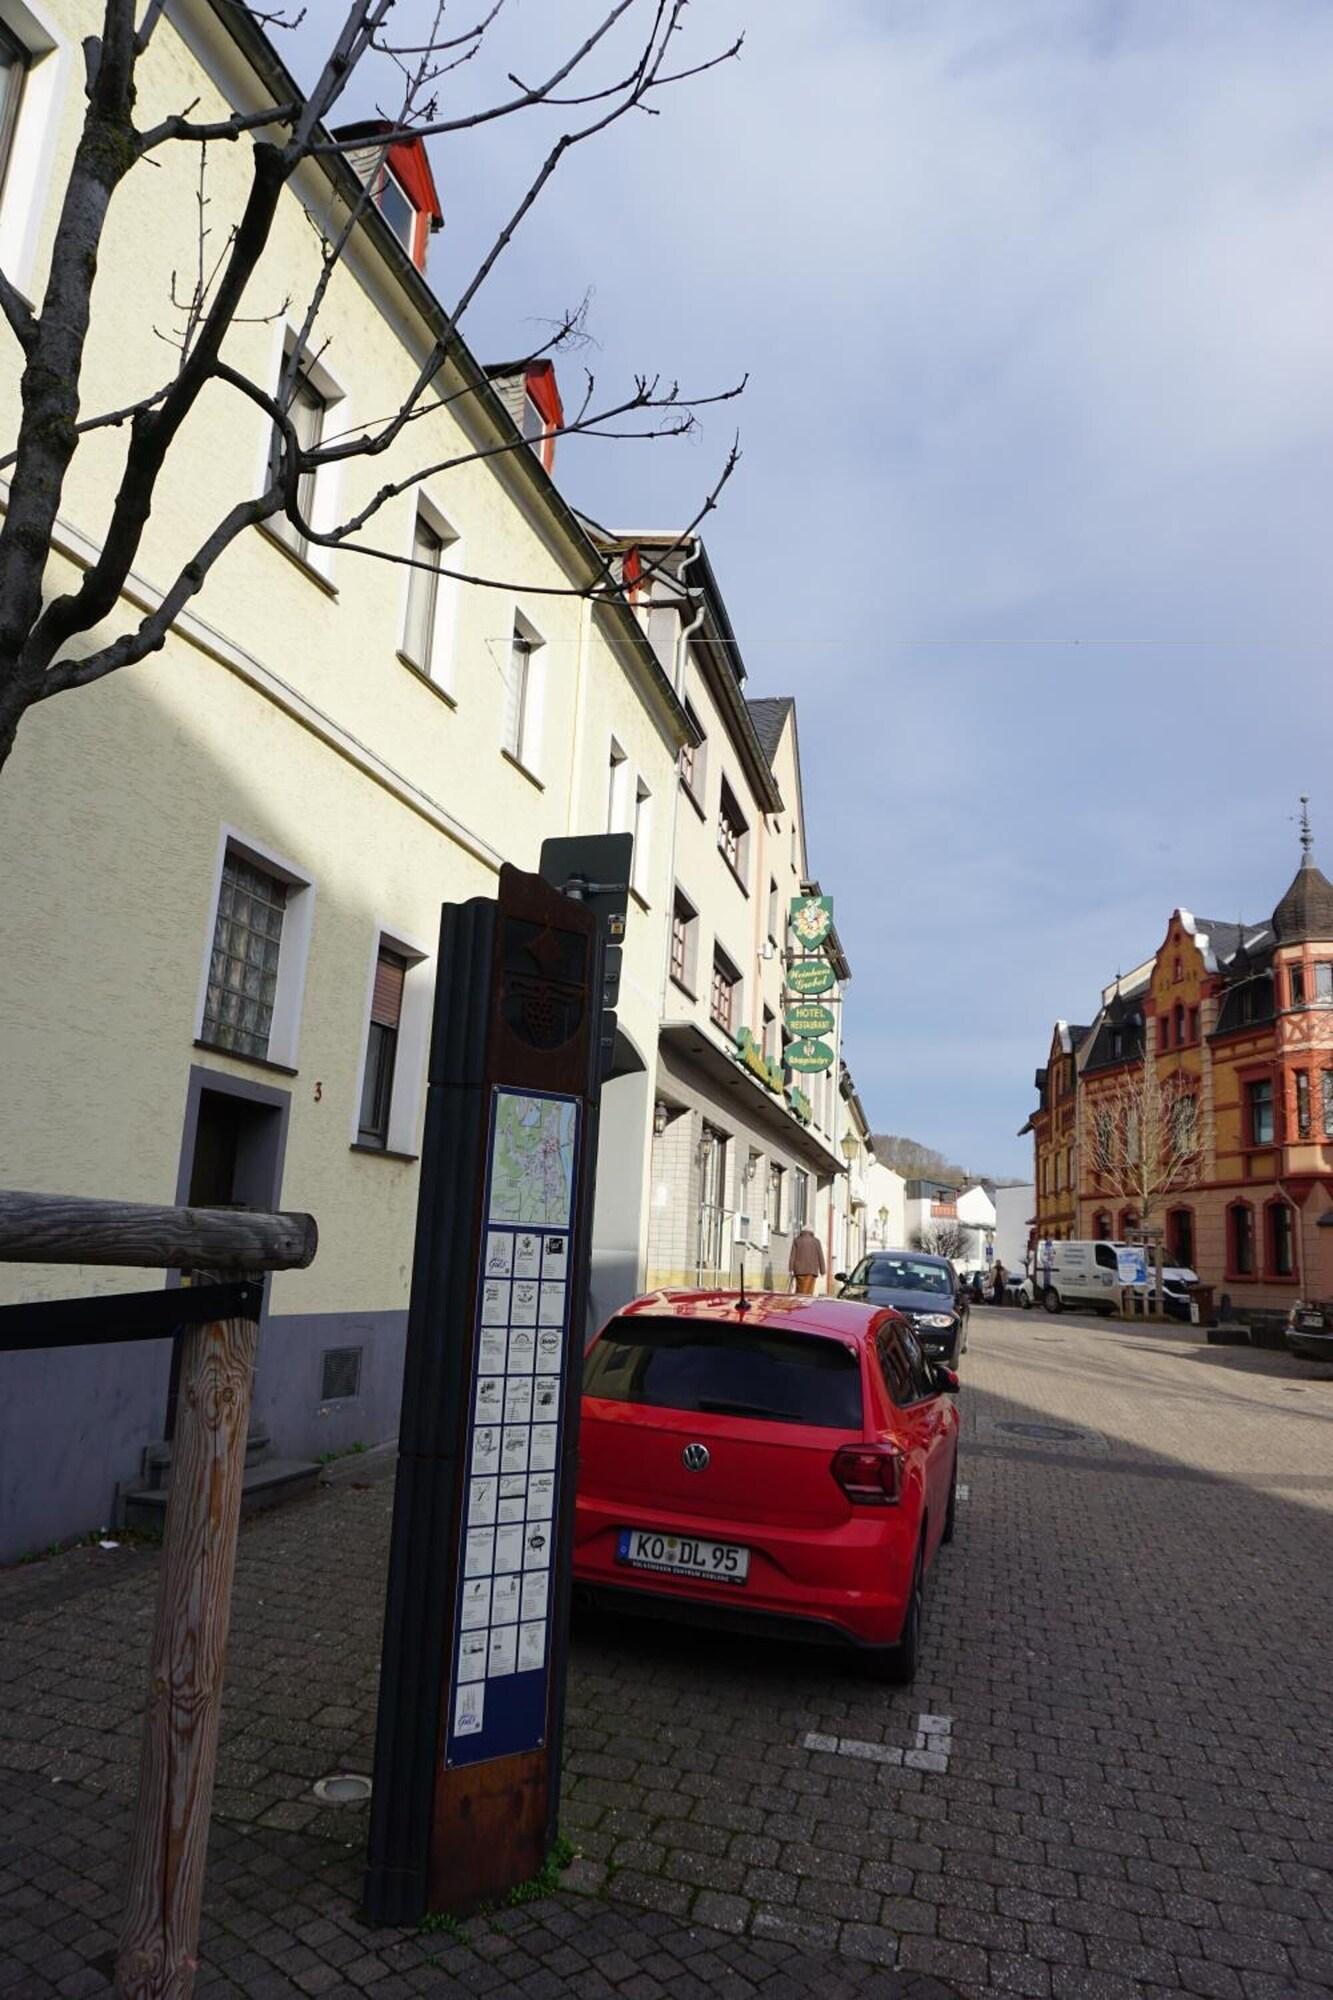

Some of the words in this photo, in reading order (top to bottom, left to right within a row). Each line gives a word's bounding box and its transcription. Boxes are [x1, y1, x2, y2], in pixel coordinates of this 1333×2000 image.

[796, 1008, 826, 1018] HOTEL
[789, 1020, 830, 1029] RESTAURANT
[314, 1081, 322, 1102] 3
[636, 1534, 665, 1560] KO
[678, 1541, 706, 1567] DL
[712, 1546, 740, 1571] 95
